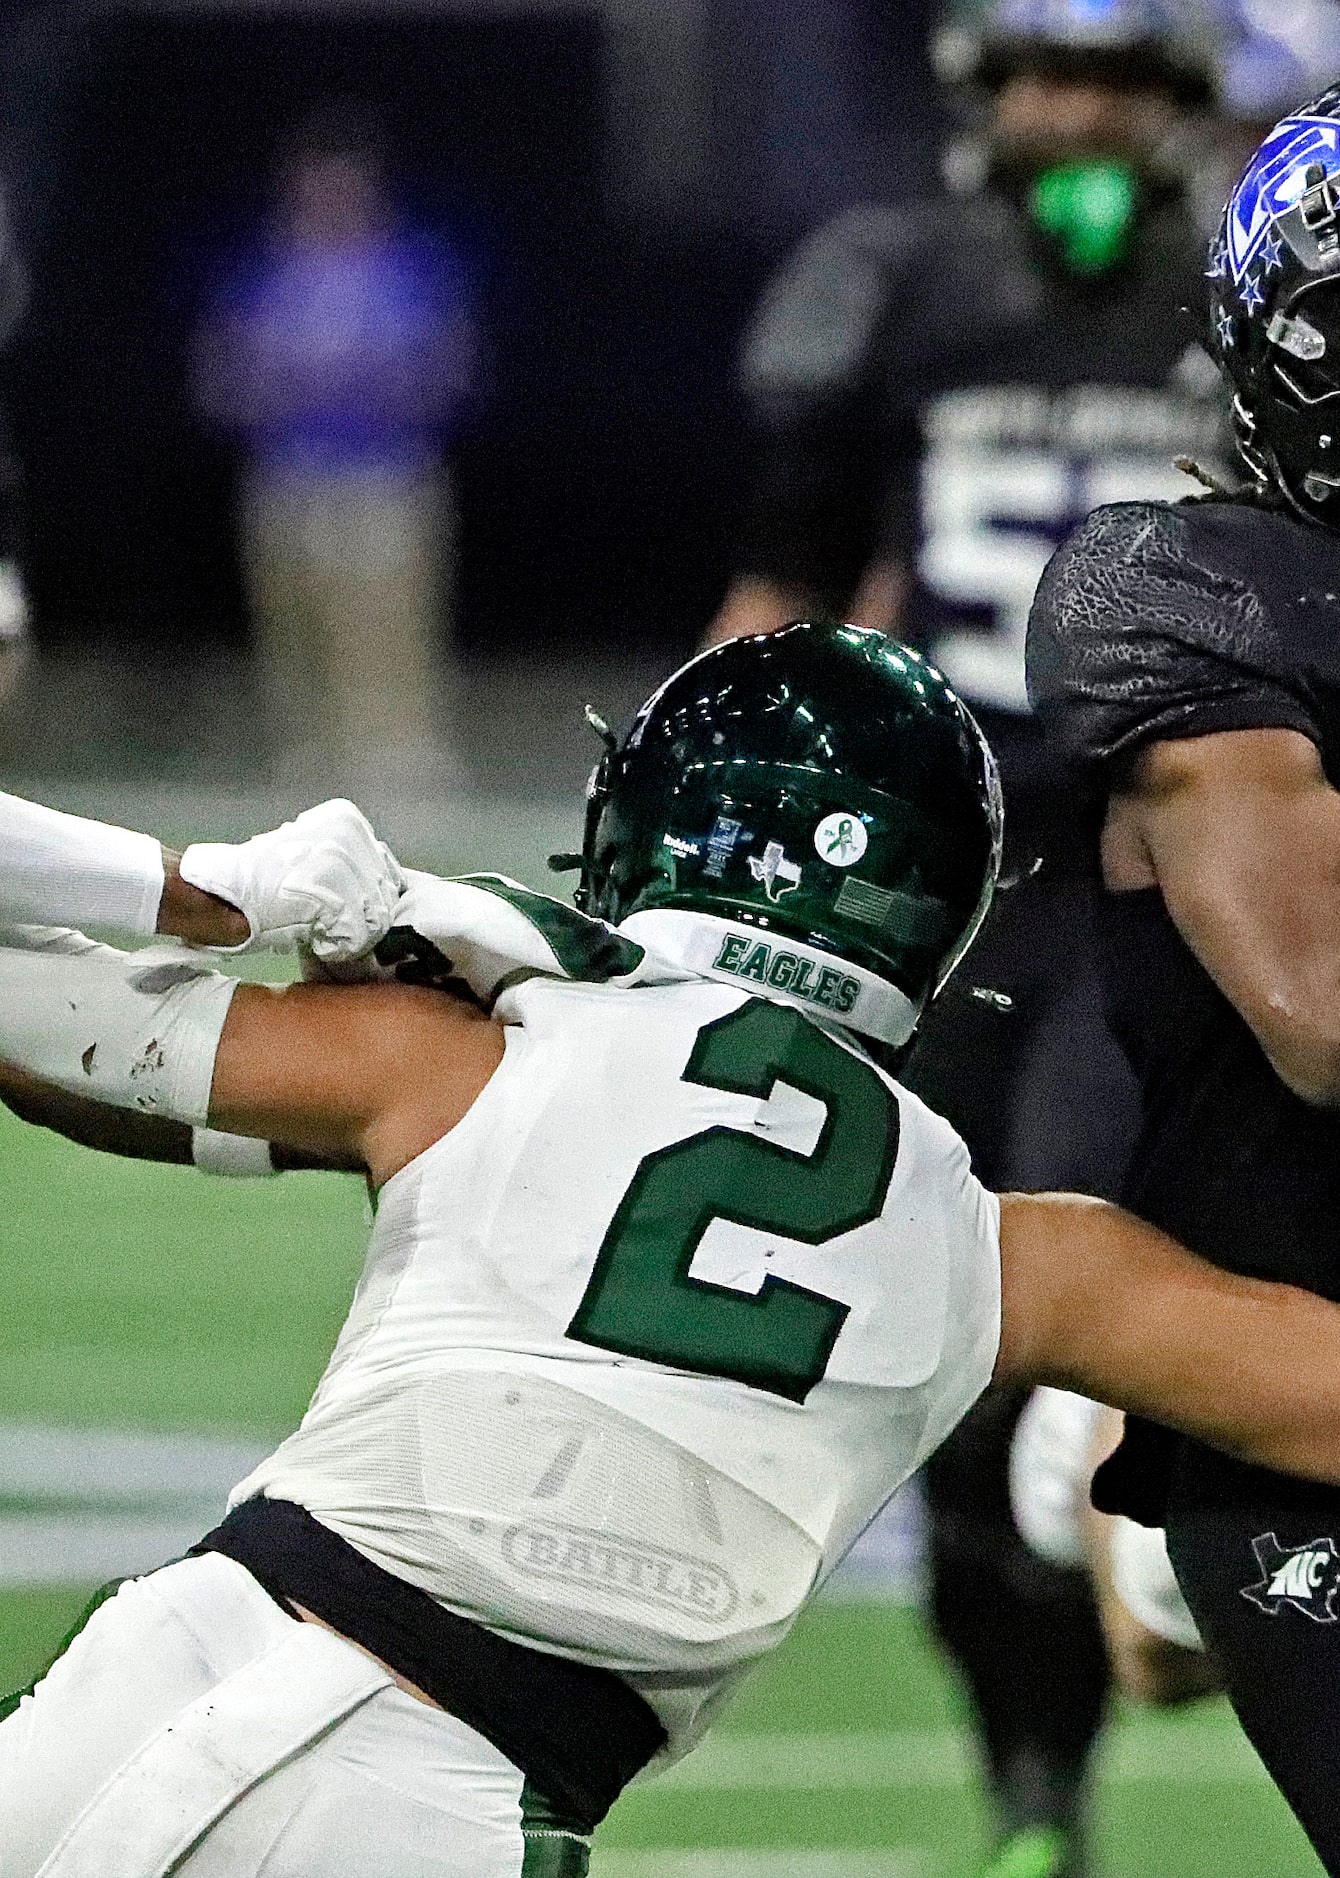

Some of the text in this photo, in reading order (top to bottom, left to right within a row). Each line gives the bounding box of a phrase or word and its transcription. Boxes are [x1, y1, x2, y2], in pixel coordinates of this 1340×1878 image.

[712, 931, 862, 1015] EAGLES
[564, 995, 901, 1406] 2
[523, 1531, 721, 1610] BATTLE
